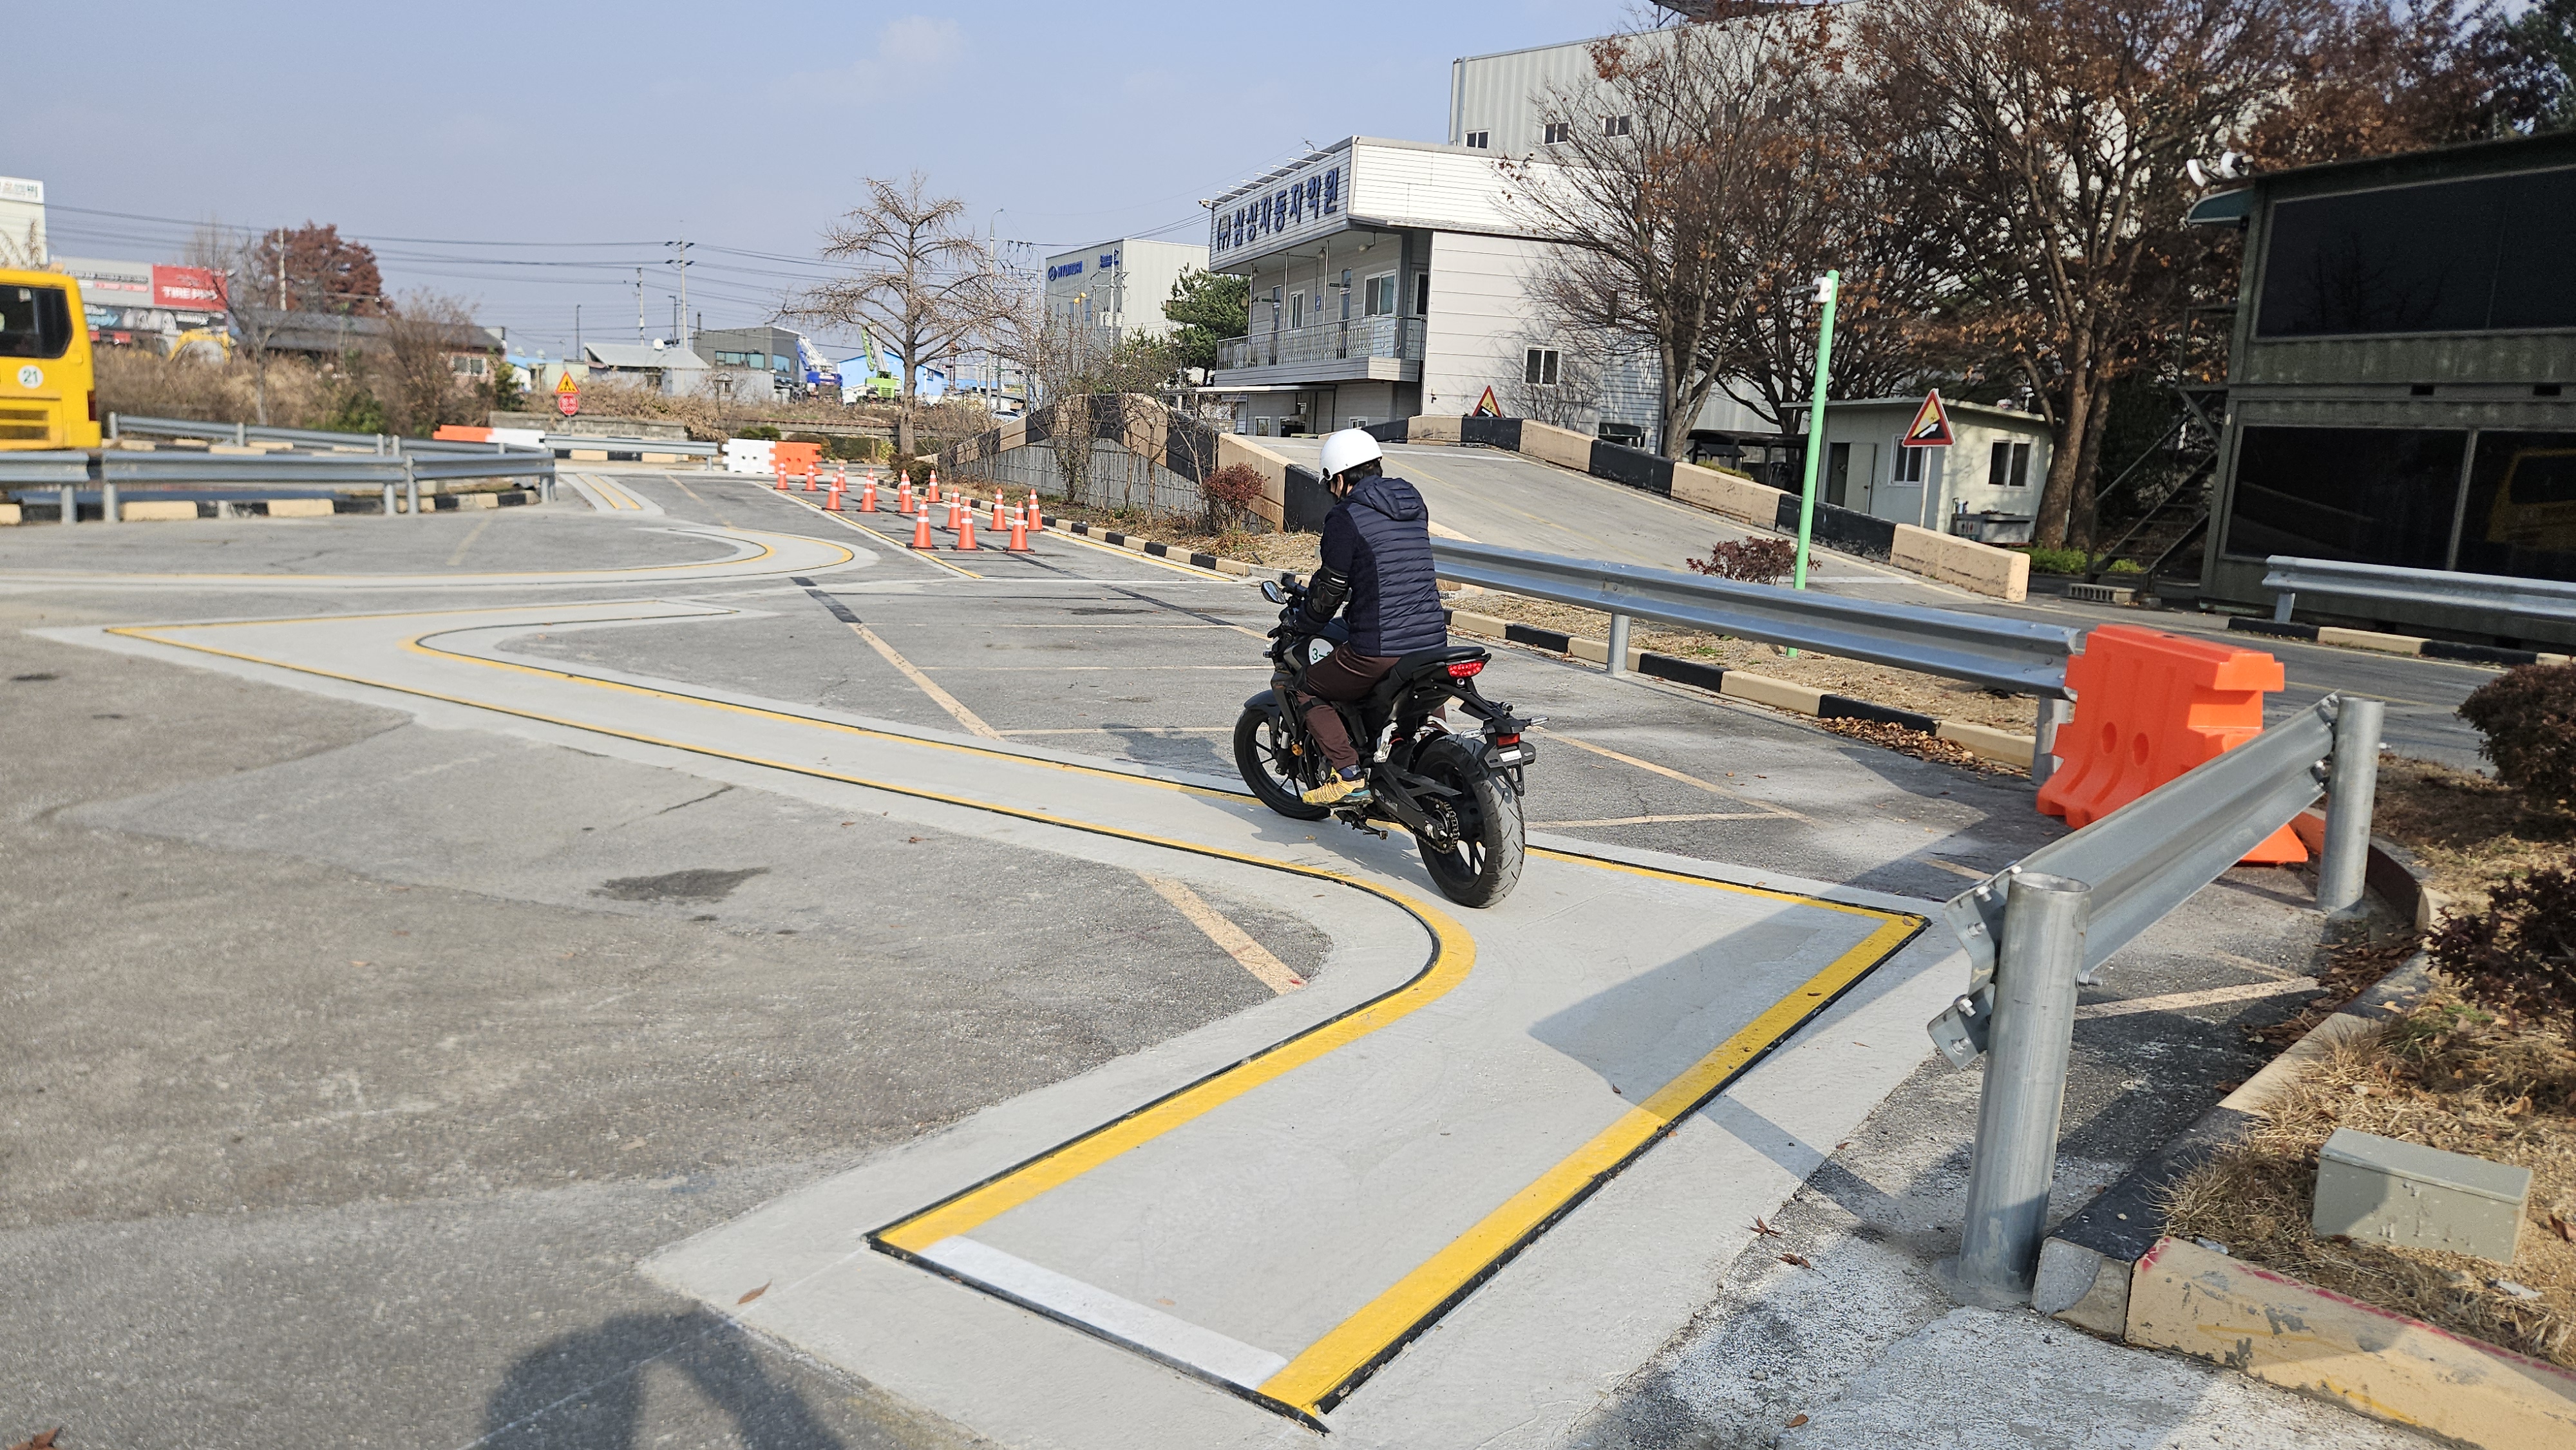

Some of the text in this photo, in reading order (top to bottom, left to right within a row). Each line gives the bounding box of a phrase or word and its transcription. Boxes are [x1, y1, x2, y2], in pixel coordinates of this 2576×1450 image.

[1057, 261, 1083, 278] HYUNDAI
[162, 286, 191, 299] TIRE
[23, 368, 37, 384] 21
